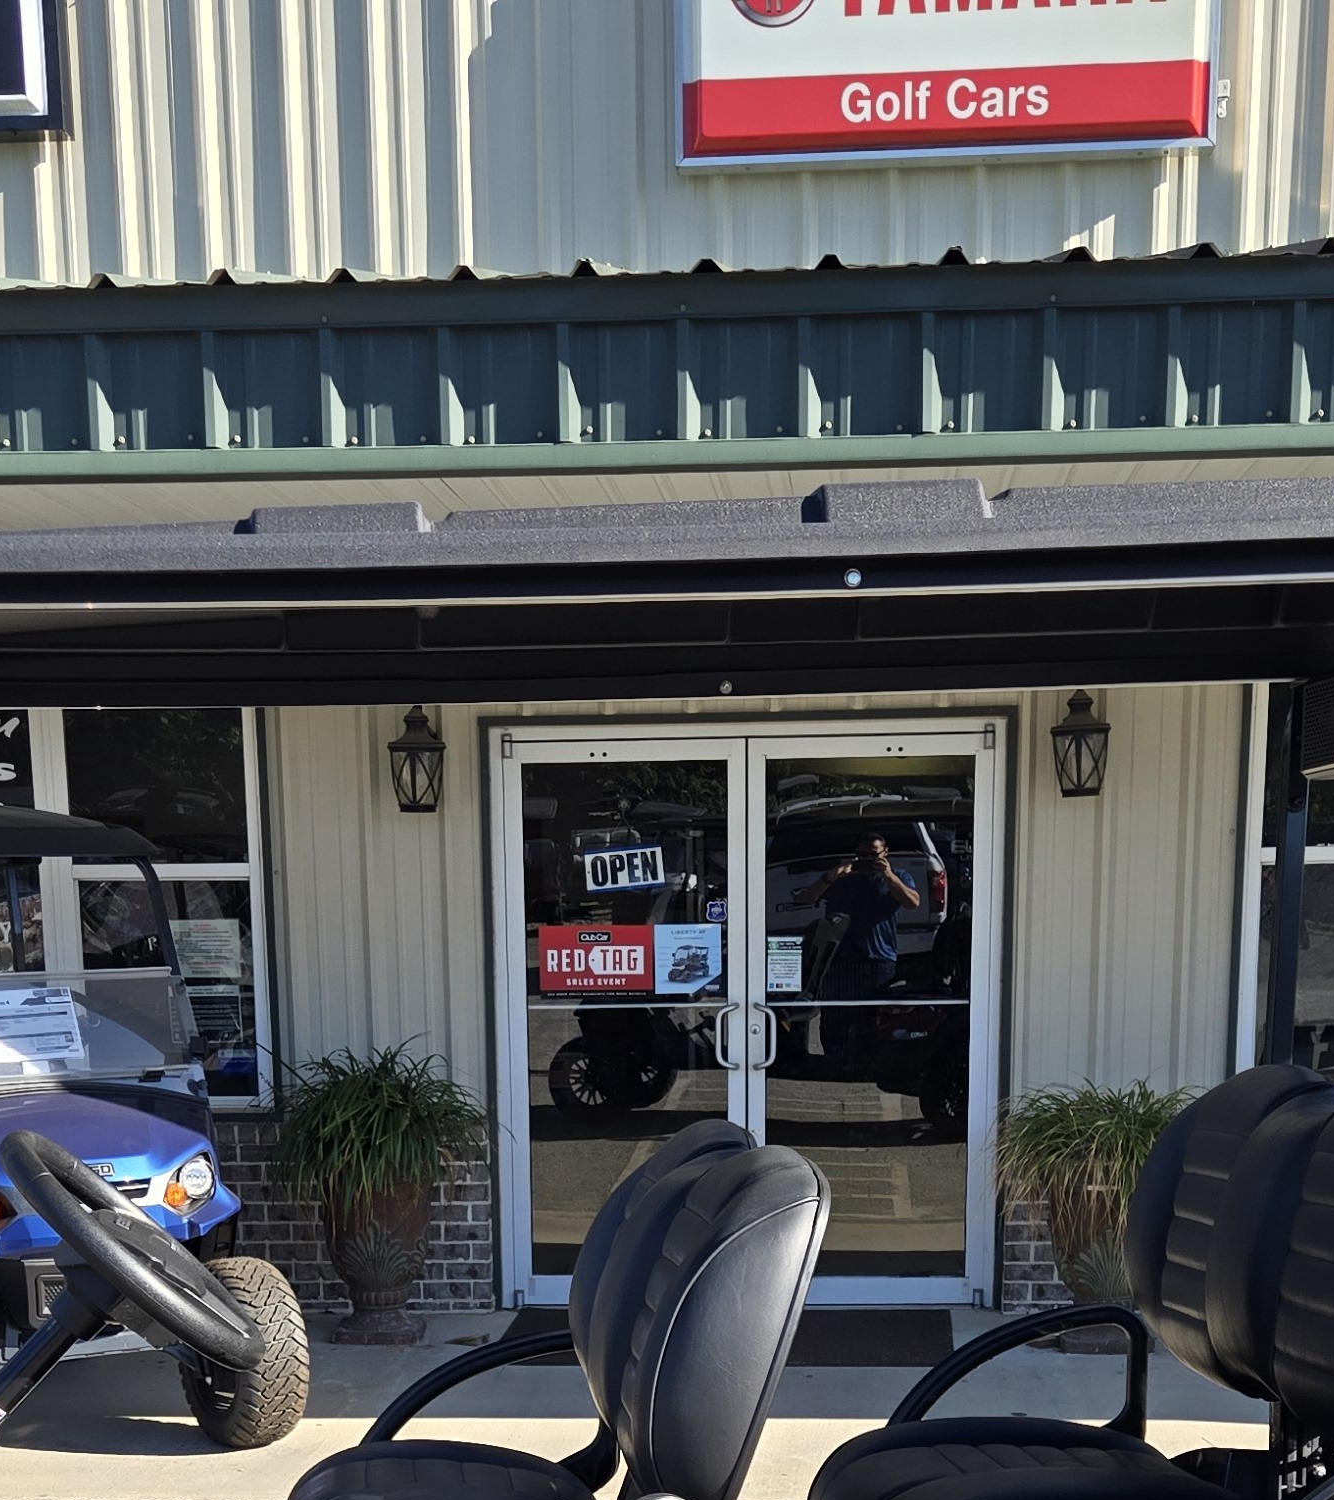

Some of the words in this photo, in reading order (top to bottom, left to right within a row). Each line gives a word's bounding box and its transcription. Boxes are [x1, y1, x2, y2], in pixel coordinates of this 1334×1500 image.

[840, 81, 931, 123] Golf
[946, 77, 1049, 119] Cars
[590, 849, 660, 888] OPEN
[547, 949, 586, 973] RED
[600, 949, 638, 972] TAG
[566, 978, 594, 986] SALES
[597, 978, 627, 986] EVENT
